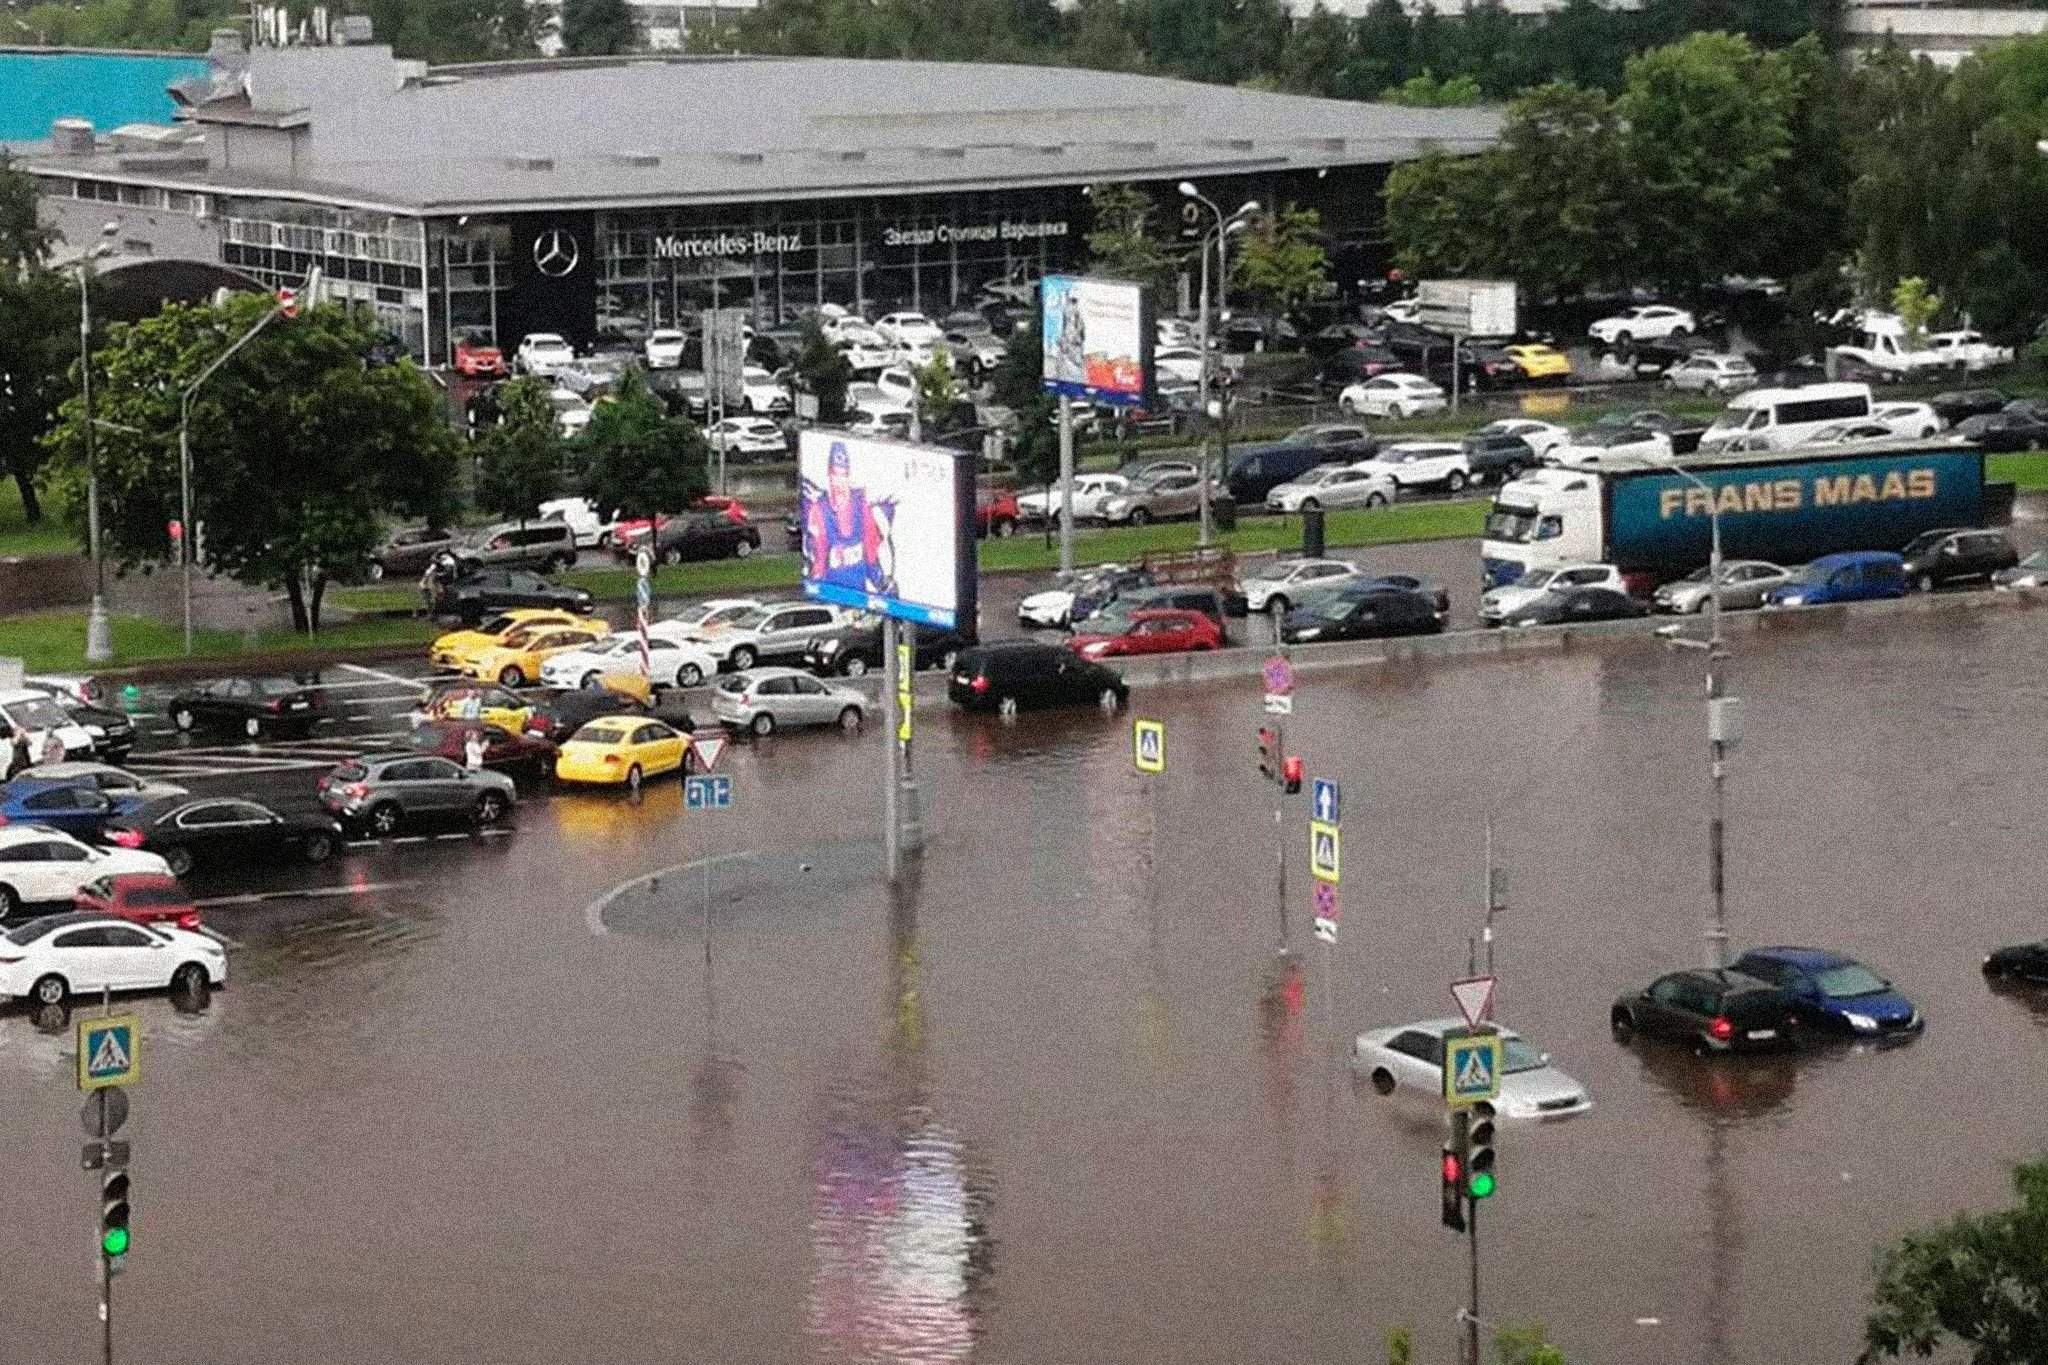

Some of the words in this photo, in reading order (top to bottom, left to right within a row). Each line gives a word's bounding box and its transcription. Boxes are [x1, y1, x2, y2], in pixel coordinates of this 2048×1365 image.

[655, 230, 801, 259] Mercedes-Benz
[1660, 479, 1801, 519] FRANS
[1814, 469, 1935, 507] MAAS
